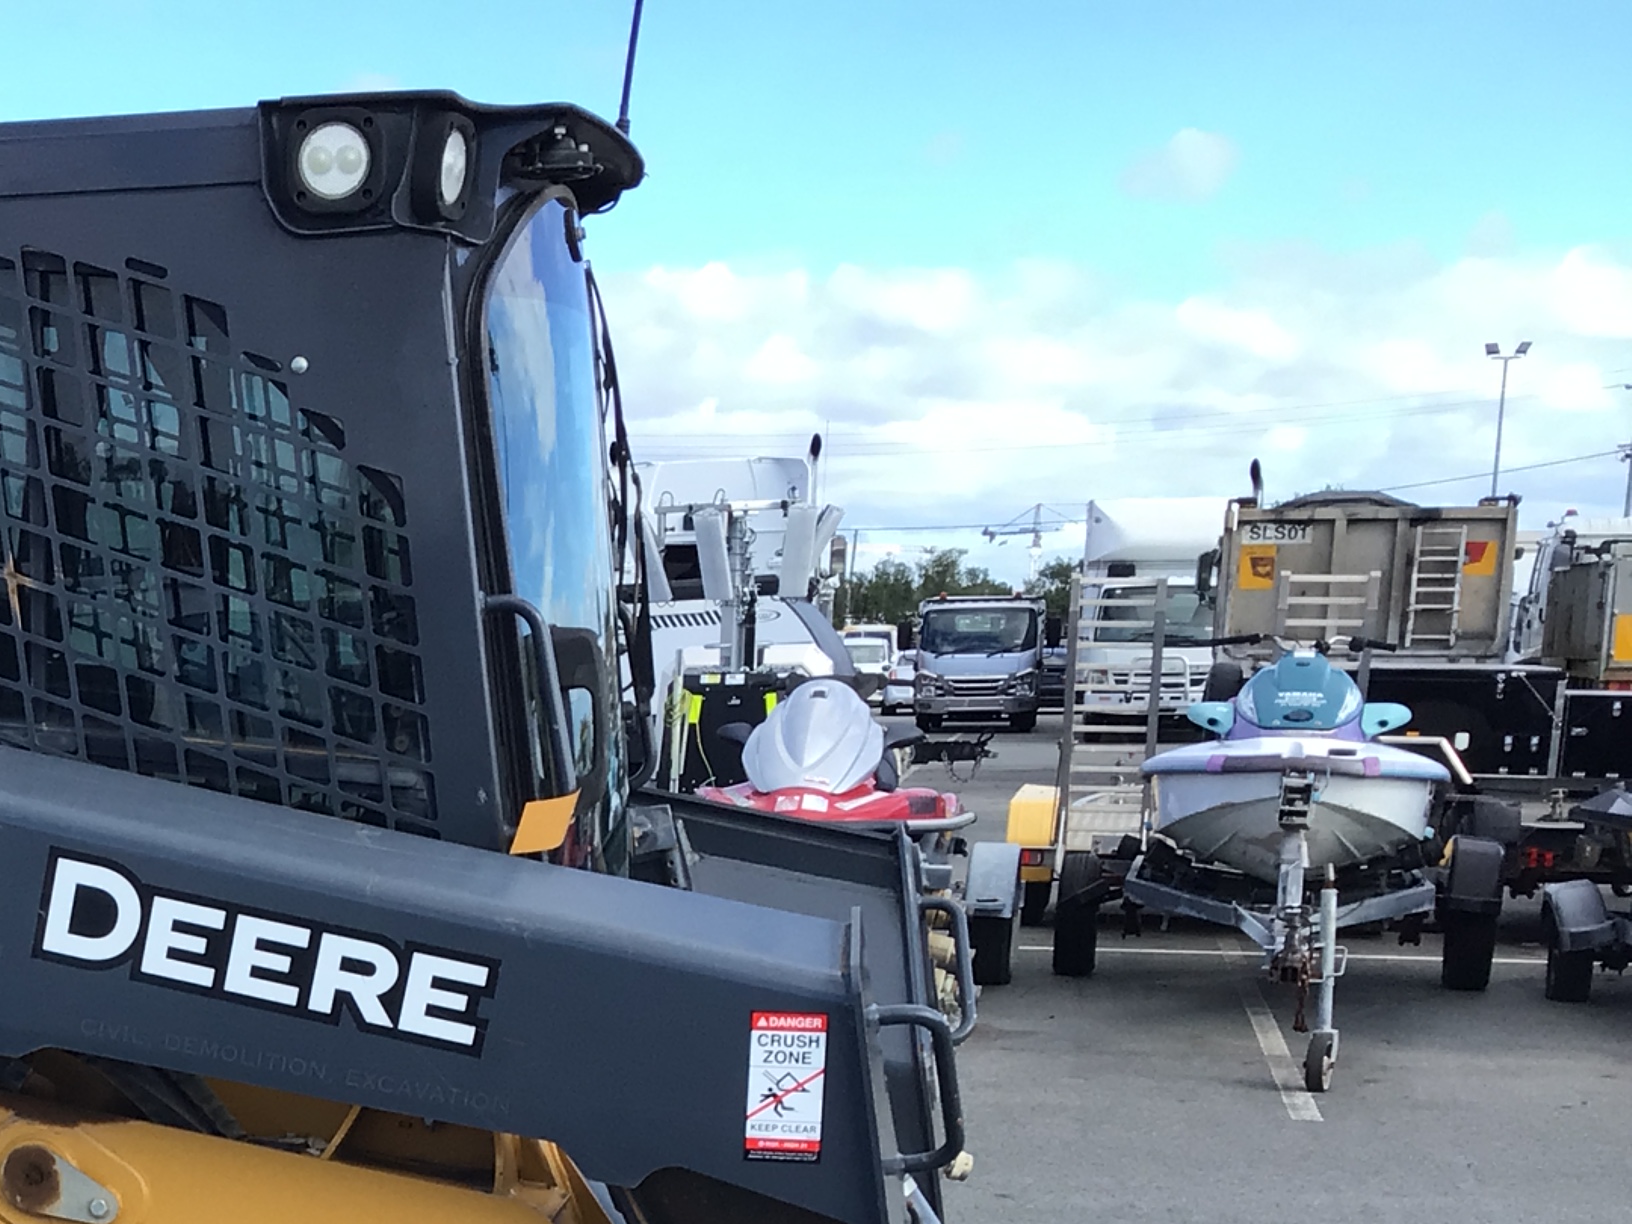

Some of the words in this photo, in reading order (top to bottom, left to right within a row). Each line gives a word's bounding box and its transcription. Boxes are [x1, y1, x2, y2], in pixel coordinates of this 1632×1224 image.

[1249, 524, 1307, 540] SLS01
[41, 857, 490, 1047] DEERE
[769, 1016, 823, 1029] DANGER
[757, 1033, 820, 1049] CRUSH
[762, 1050, 812, 1065] ZONE
[344, 1068, 512, 1116] EXCAVATION
[750, 1123, 779, 1133] KEEP
[780, 1124, 817, 1134] CLEAR
